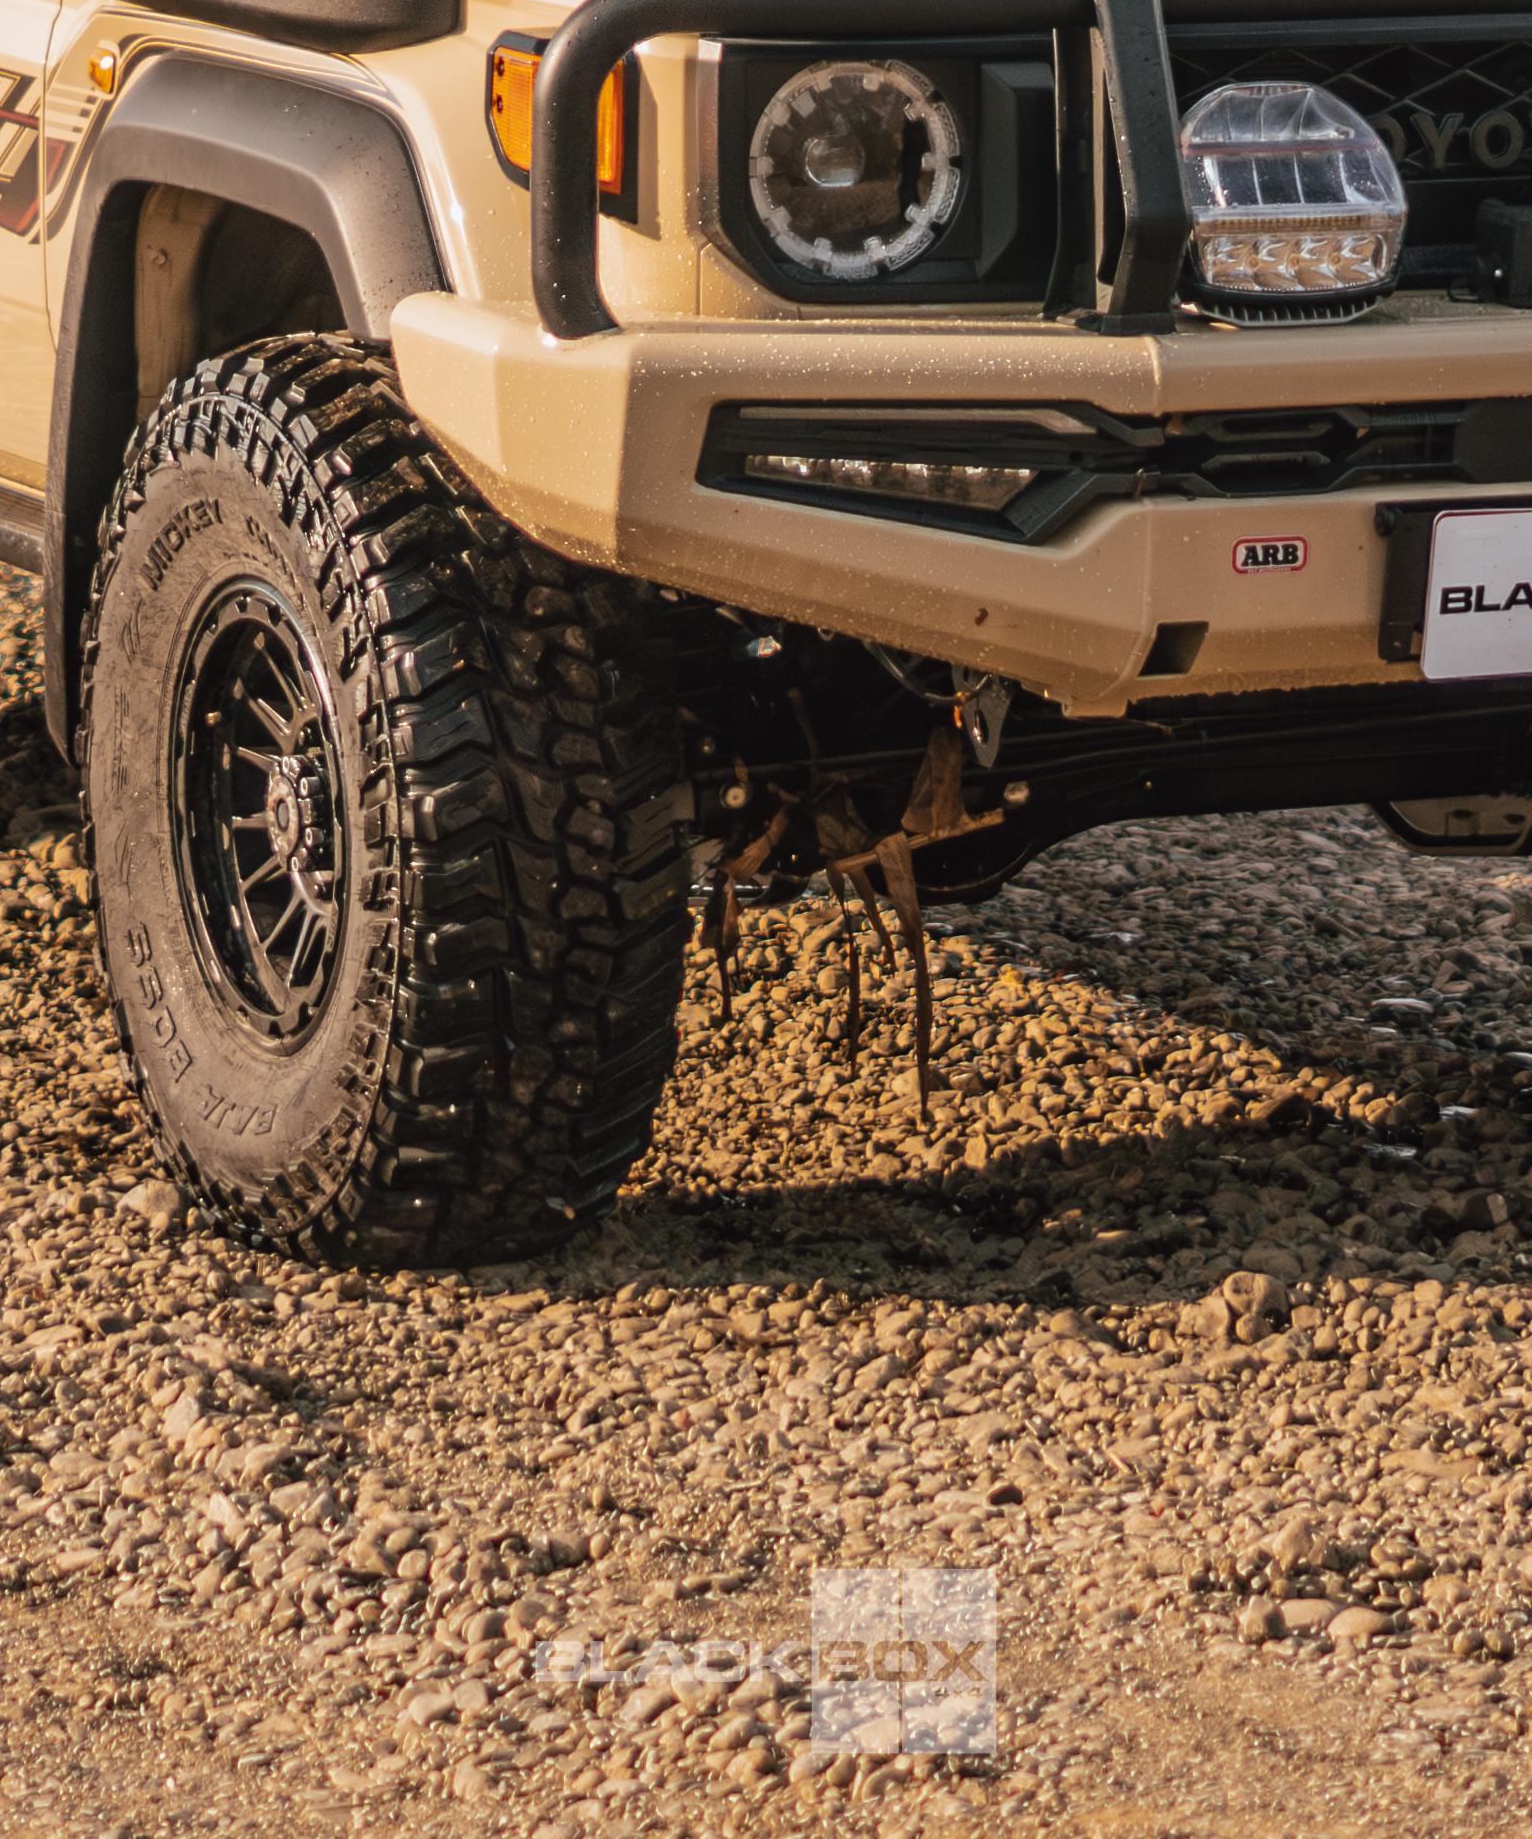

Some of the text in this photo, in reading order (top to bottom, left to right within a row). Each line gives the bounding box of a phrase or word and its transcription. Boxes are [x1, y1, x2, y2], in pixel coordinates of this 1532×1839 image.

[139, 498, 224, 592] MICKEY
[1241, 543, 1300, 567] ARB
[126, 920, 194, 1084] BOSS
